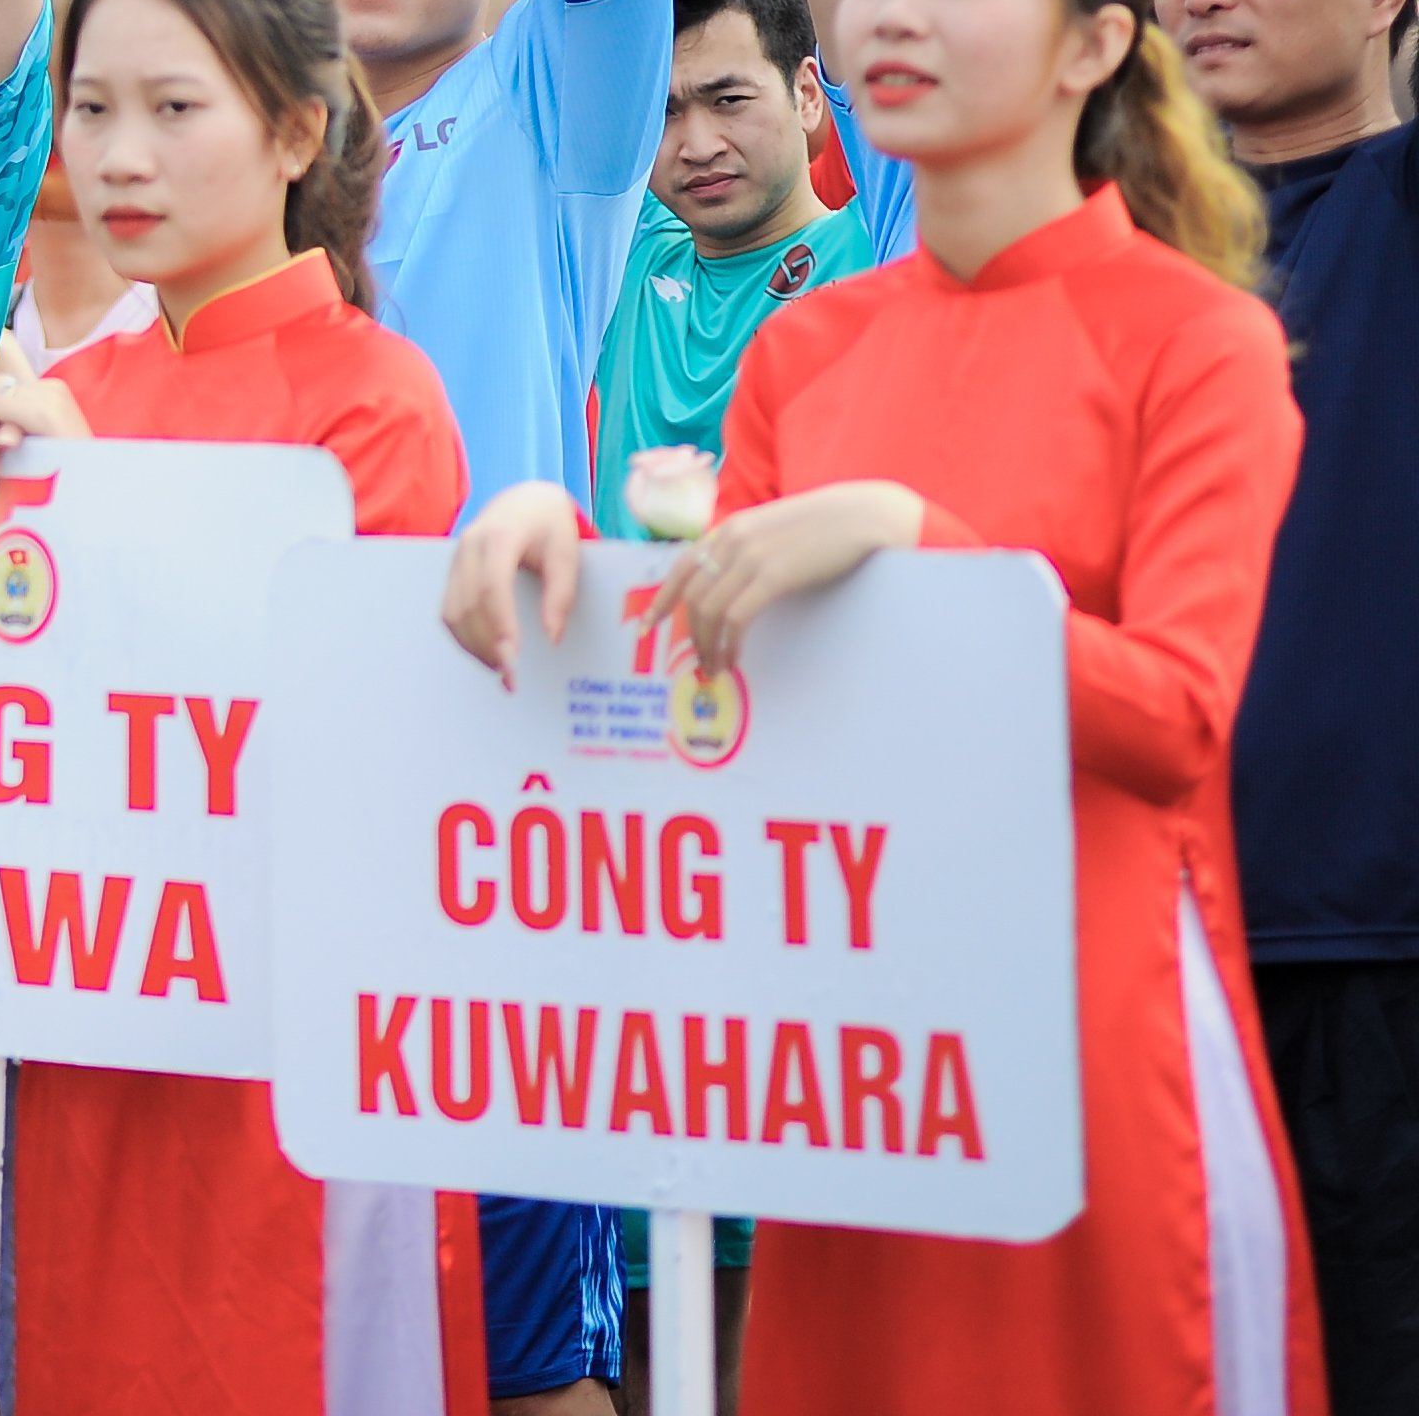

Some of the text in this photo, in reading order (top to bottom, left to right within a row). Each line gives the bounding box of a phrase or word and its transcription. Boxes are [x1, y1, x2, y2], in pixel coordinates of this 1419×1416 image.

[107, 691, 258, 817] TY
[436, 772, 887, 950] CÔNG TY
[357, 992, 984, 1161] KUWAHARA
